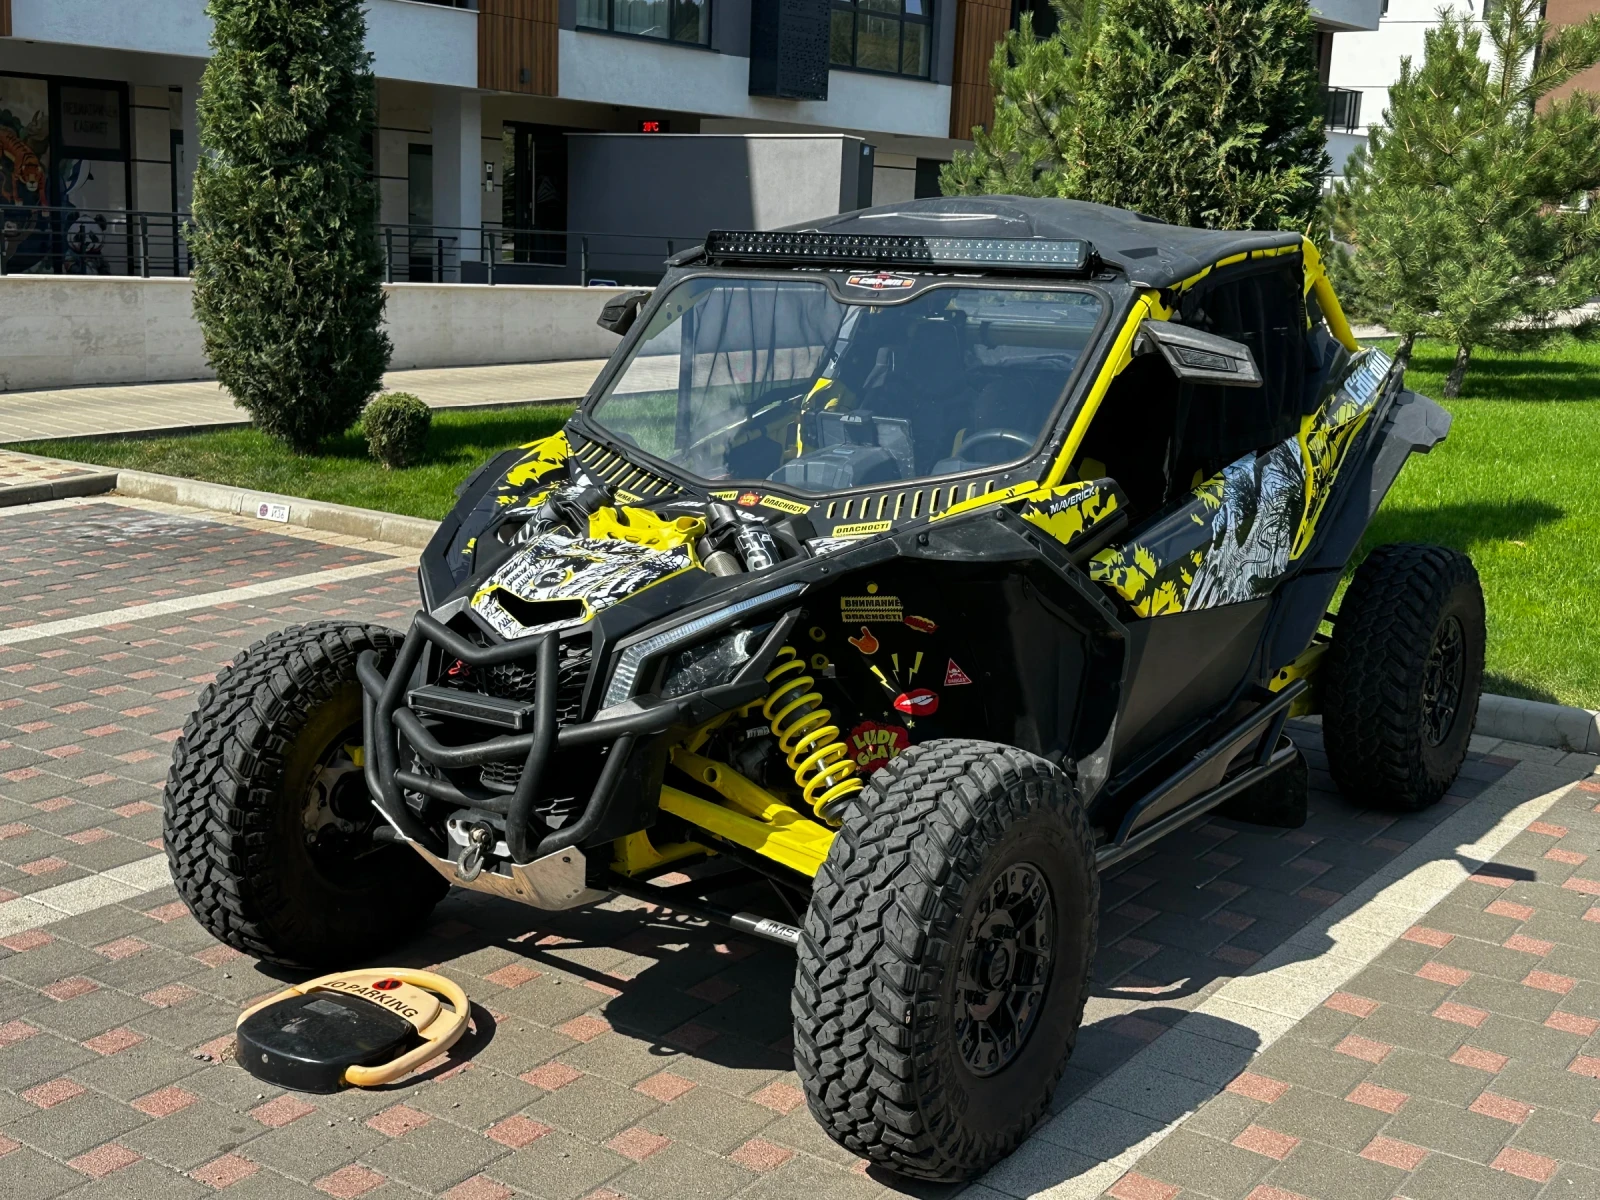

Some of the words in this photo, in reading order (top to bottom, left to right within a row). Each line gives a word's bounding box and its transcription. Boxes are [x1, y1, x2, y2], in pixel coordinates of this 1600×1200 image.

[1050, 486, 1095, 514] MAVERICK
[852, 729, 898, 750] LUDI
[857, 745, 901, 766] GLAV
[344, 984, 419, 1018] PARKING
